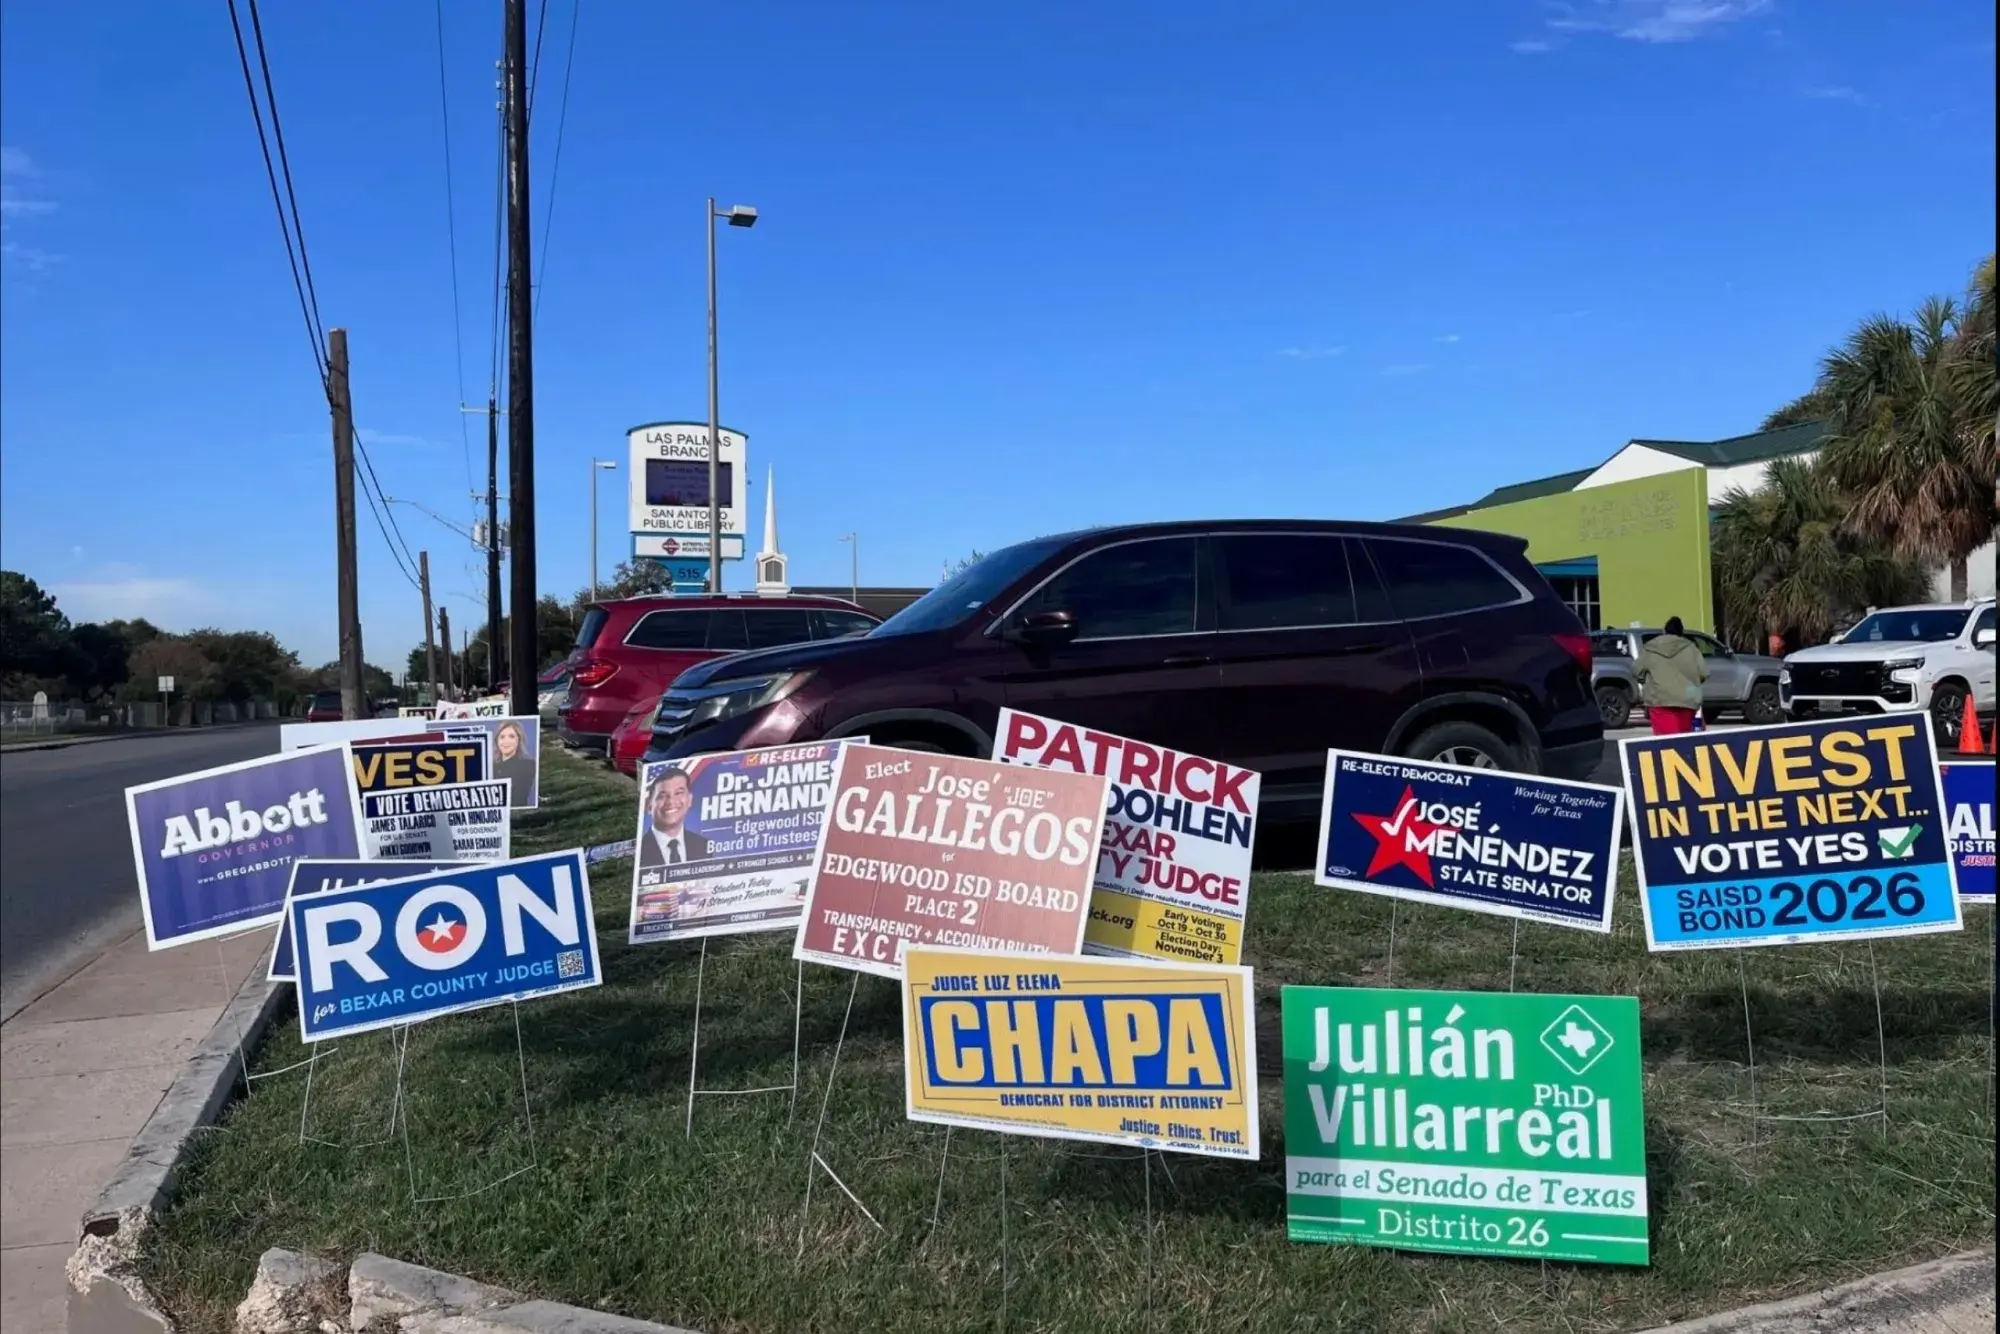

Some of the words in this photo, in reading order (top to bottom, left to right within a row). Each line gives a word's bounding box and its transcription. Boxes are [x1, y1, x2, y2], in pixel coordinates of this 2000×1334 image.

[646, 433, 672, 444] LAS
[660, 445, 708, 458] BRANC
[643, 519, 684, 529] PUBLIC
[687, 520, 735, 530] LIBRRY
[651, 509, 674, 518] SAN
[677, 510, 728, 520] ANTOO
[678, 568, 700, 579] 515
[475, 704, 504, 717] VOTE
[759, 746, 825, 765] RE-ELECT
[1004, 712, 1254, 815] PATRICK
[1638, 724, 1915, 803] INVEST
[354, 748, 475, 789] VEST
[865, 759, 912, 780] Elect
[1342, 759, 1399, 778] RE-ELECT
[1402, 768, 1473, 787] DEMOCRAT
[717, 772, 755, 794] Dr.
[375, 793, 410, 815] VOTE
[413, 785, 504, 812] DEMOCRATIC!
[701, 782, 829, 821] HERNAND
[1004, 785, 1054, 809] "JOE"
[1514, 786, 1557, 804] Working
[1560, 791, 1607, 809] Together
[160, 787, 328, 859] Abbott
[371, 818, 396, 833] JAMES
[398, 814, 436, 830] TALARICO
[448, 812, 467, 826] GINA
[735, 814, 799, 836] Edgewood
[803, 811, 824, 826] ISD
[1415, 801, 1482, 831] JOSÉ
[1531, 803, 1546, 817] for
[1549, 806, 1583, 820] Texas
[1646, 807, 1690, 838] IN
[1699, 798, 1788, 834] THE
[1797, 786, 1929, 827] NEXT...
[1949, 803, 1996, 839] AL
[405, 830, 428, 839] SENATE
[836, 786, 1093, 867] GALLEGOS
[198, 834, 295, 863] GOVERNOR
[707, 835, 744, 854] Board
[746, 834, 760, 848] of
[763, 830, 818, 847] Trustees
[1101, 821, 1176, 861] EXAR
[1405, 823, 1595, 882] MENÉNDEZ
[1674, 838, 1783, 875] VOTE
[1785, 832, 1869, 867] YES
[1950, 841, 1995, 852] DISTR
[737, 858, 766, 869] STRONGER
[767, 855, 794, 865] SCHOOLS
[942, 852, 955, 863] for
[669, 868, 690, 878] STRONG
[691, 864, 725, 875] LEADERSHIP
[823, 853, 950, 892] EDGEWOOD
[953, 873, 991, 898] ISD
[995, 880, 1079, 913] BOARD
[1135, 857, 1241, 905] JUDGE
[1440, 865, 1499, 888] STATE
[1502, 876, 1593, 905] SENATOR
[1677, 885, 1762, 910] SAISD
[904, 894, 956, 920] PLACE
[960, 900, 980, 927] 2
[1094, 880, 1126, 893] untability
[1131, 887, 1155, 898] Deliver
[1192, 902, 1213, 913] empty
[1213, 907, 1243, 919] promises
[1769, 872, 1925, 926] 2026
[303, 865, 581, 993] RON
[731, 912, 766, 922] COMMUNITY
[823, 909, 922, 940] TRANSPARENCY
[1090, 908, 1134, 930] ick.org
[1165, 909, 1189, 924] Early
[1191, 915, 1226, 931] Voting:
[1679, 907, 1766, 933] BOND
[1157, 919, 1175, 930] Oct
[1178, 922, 1188, 933] 19
[1195, 927, 1212, 939] Oct
[1215, 931, 1226, 942] 30
[1160, 931, 1198, 948] Election
[1200, 939, 1222, 953] Day:
[1155, 940, 1214, 963] November
[1216, 953, 1224, 964] 3
[312, 1001, 337, 1024] for
[340, 989, 405, 1014] BEXAR
[411, 972, 489, 1000] COUNTY
[495, 960, 555, 985] JUDGE
[931, 975, 979, 992] JUDGE
[984, 975, 1011, 991] LUZ
[1016, 973, 1061, 991] ELENA
[929, 998, 1225, 1087] CHAPA
[1308, 1003, 1515, 1080] Julián
[1000, 1093, 1064, 1107] DEMOCRAT
[1069, 1094, 1092, 1108] FOR
[1097, 1094, 1155, 1109] DISTRICT
[1160, 1095, 1224, 1110] ATTORNEY
[1533, 1084, 1594, 1108] PhD
[1120, 1116, 1163, 1136] Justice.
[1168, 1122, 1205, 1141] Ethics.
[1209, 1127, 1245, 1145] Trust.
[1307, 1082, 1613, 1160] Villarreal
[1296, 1170, 1347, 1190] para
[1352, 1170, 1371, 1189] el
[1376, 1169, 1488, 1201] Senado
[1496, 1176, 1532, 1202] de
[1540, 1178, 1636, 1209] Texas
[1377, 1208, 1501, 1242] Distrito
[1507, 1216, 1550, 1247] 26
